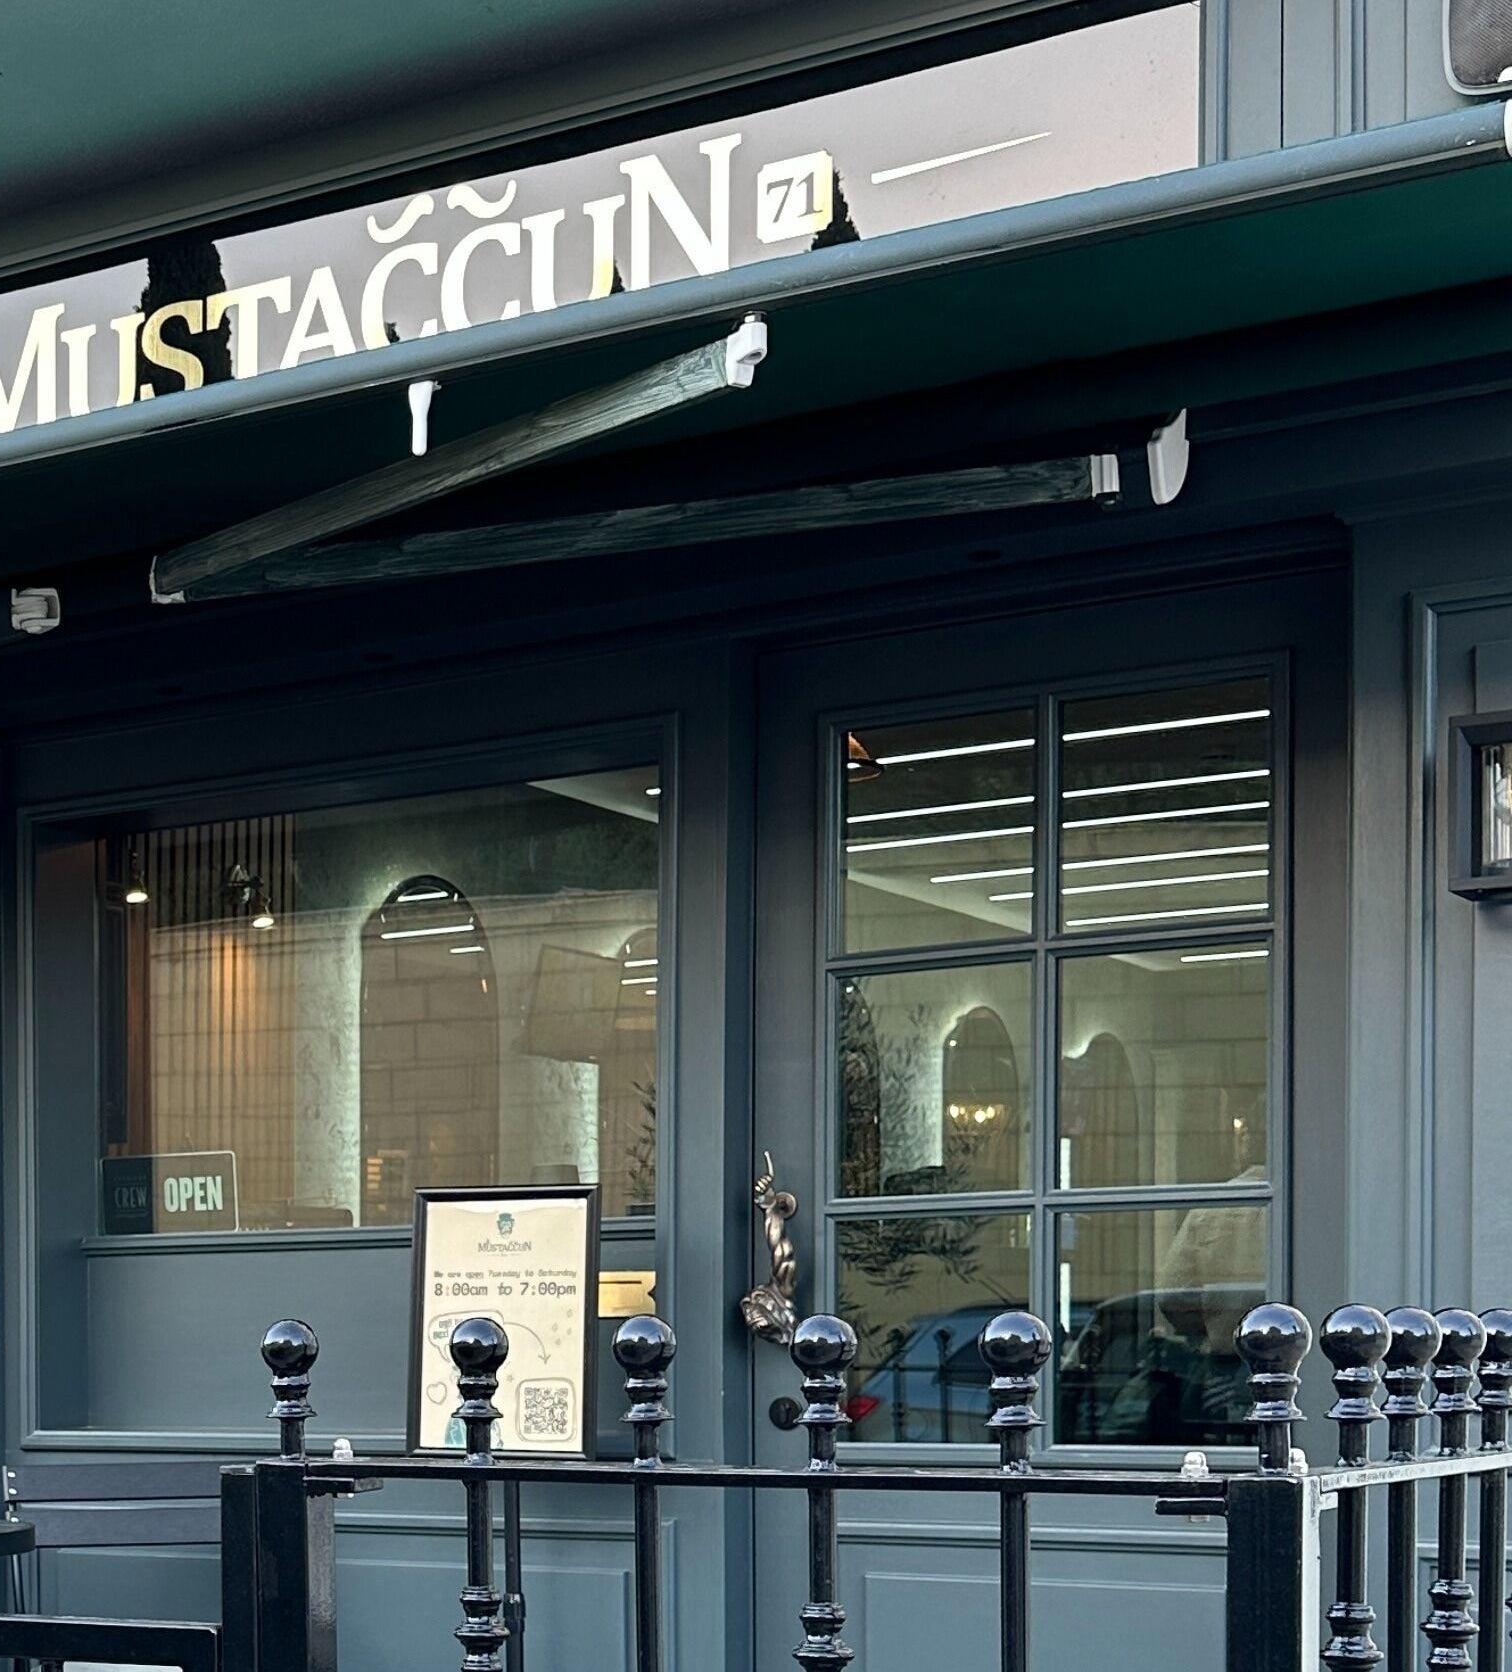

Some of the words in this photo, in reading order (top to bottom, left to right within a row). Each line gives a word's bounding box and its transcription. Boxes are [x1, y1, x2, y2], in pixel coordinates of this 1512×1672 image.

[765, 171, 825, 224] 71
[114, 1185, 148, 1209] CREW
[163, 1175, 224, 1213] OPEN
[465, 1272, 484, 1280] open
[488, 1270, 521, 1279] Tuesday
[525, 1270, 534, 1278] to
[538, 1269, 577, 1278] Saturday
[433, 1282, 489, 1297] 8:00am
[497, 1281, 513, 1296] to
[519, 1281, 577, 1298] 7:00pm
